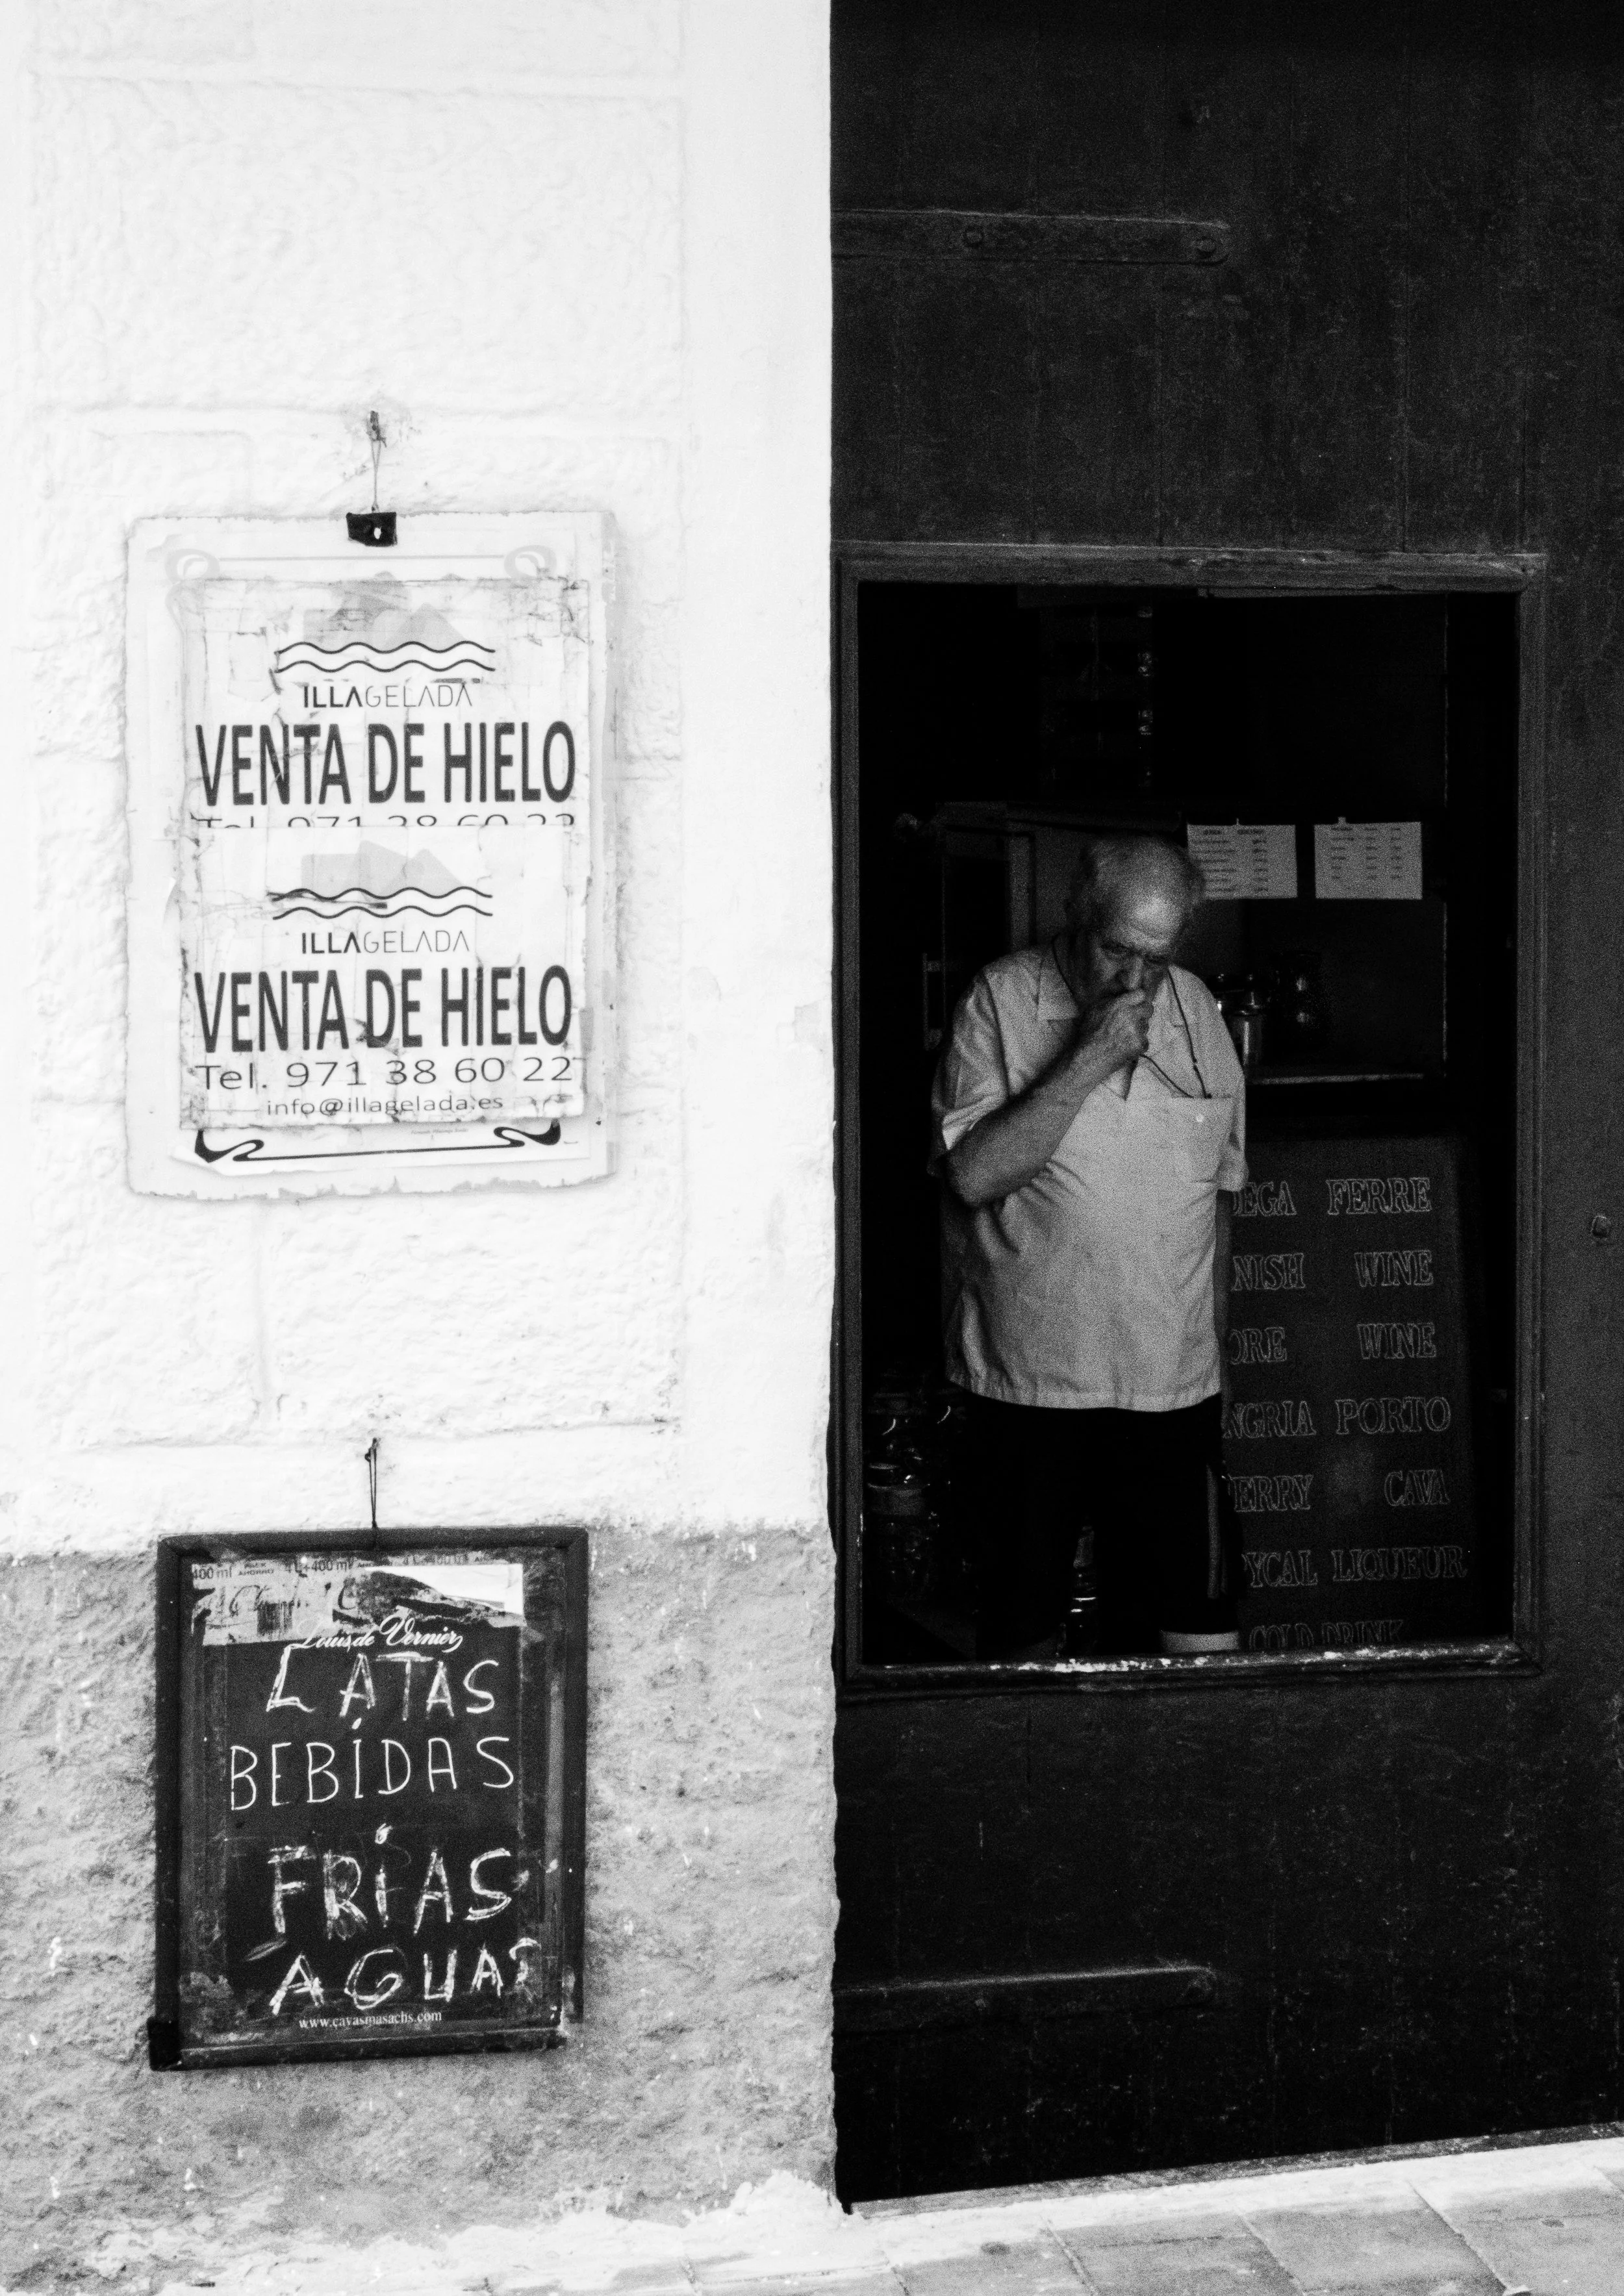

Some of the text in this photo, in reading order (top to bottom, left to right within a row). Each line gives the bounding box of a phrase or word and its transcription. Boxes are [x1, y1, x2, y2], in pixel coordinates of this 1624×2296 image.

[303, 684, 473, 709] ILLAGELADA
[196, 720, 576, 807] VENTA DE HIELO
[301, 930, 470, 954] ILLAGELADA
[194, 965, 573, 1053] VENTA DE HIELO
[195, 1056, 573, 1091] Tel. 971 38 60 22
[267, 1094, 503, 1116] info@illagelada.es
[1325, 1177, 1433, 1216] FERRE
[1354, 1250, 1434, 1287] WINE
[1356, 1321, 1438, 1360] WINE
[1334, 1396, 1453, 1435] PORTO
[1227, 1469, 1452, 1513] ERRY CAVA
[1241, 1545, 1469, 1589] YCAL LIQUEUR
[379, 1614, 464, 1654] Vernier
[266, 1643, 499, 1721] LATAS
